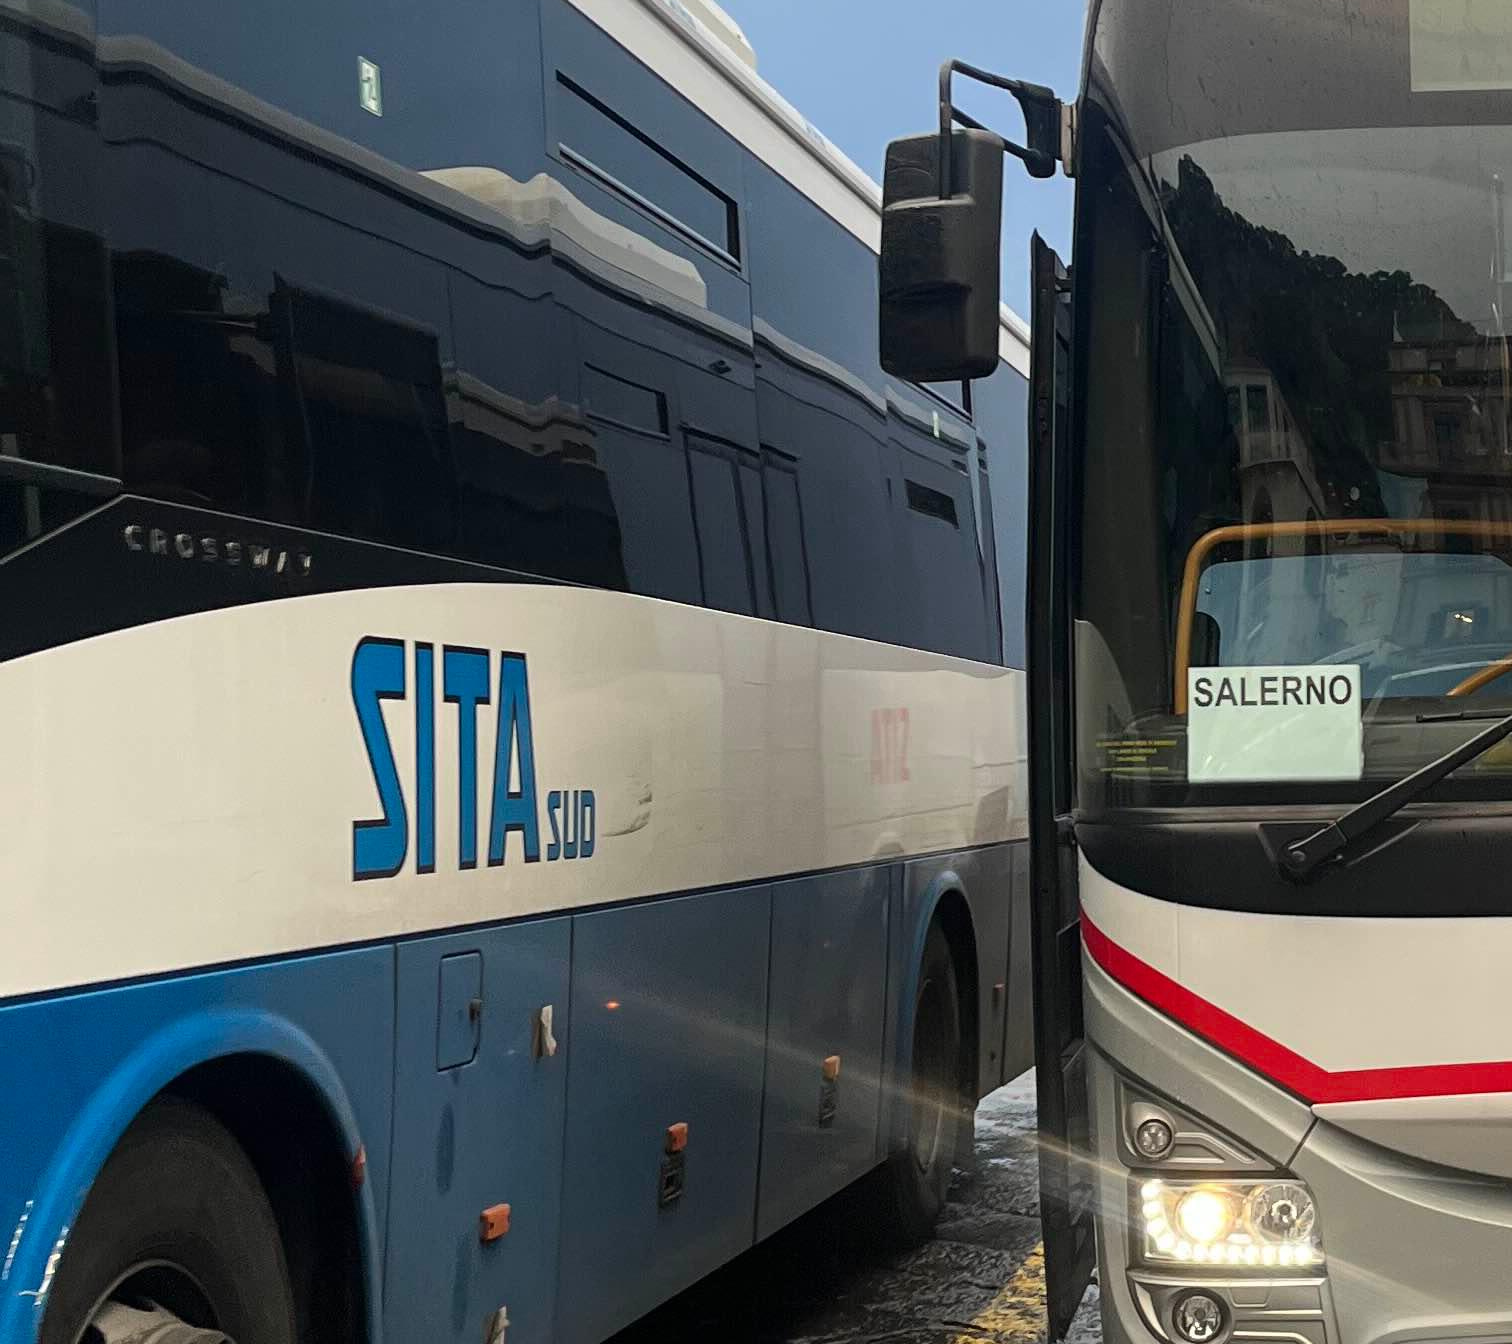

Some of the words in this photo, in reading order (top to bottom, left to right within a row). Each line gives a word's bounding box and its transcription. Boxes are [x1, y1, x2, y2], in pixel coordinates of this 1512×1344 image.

[351, 635, 541, 882] SITA
[546, 789, 596, 862] SUD
[1194, 675, 1352, 707] SALERNO
